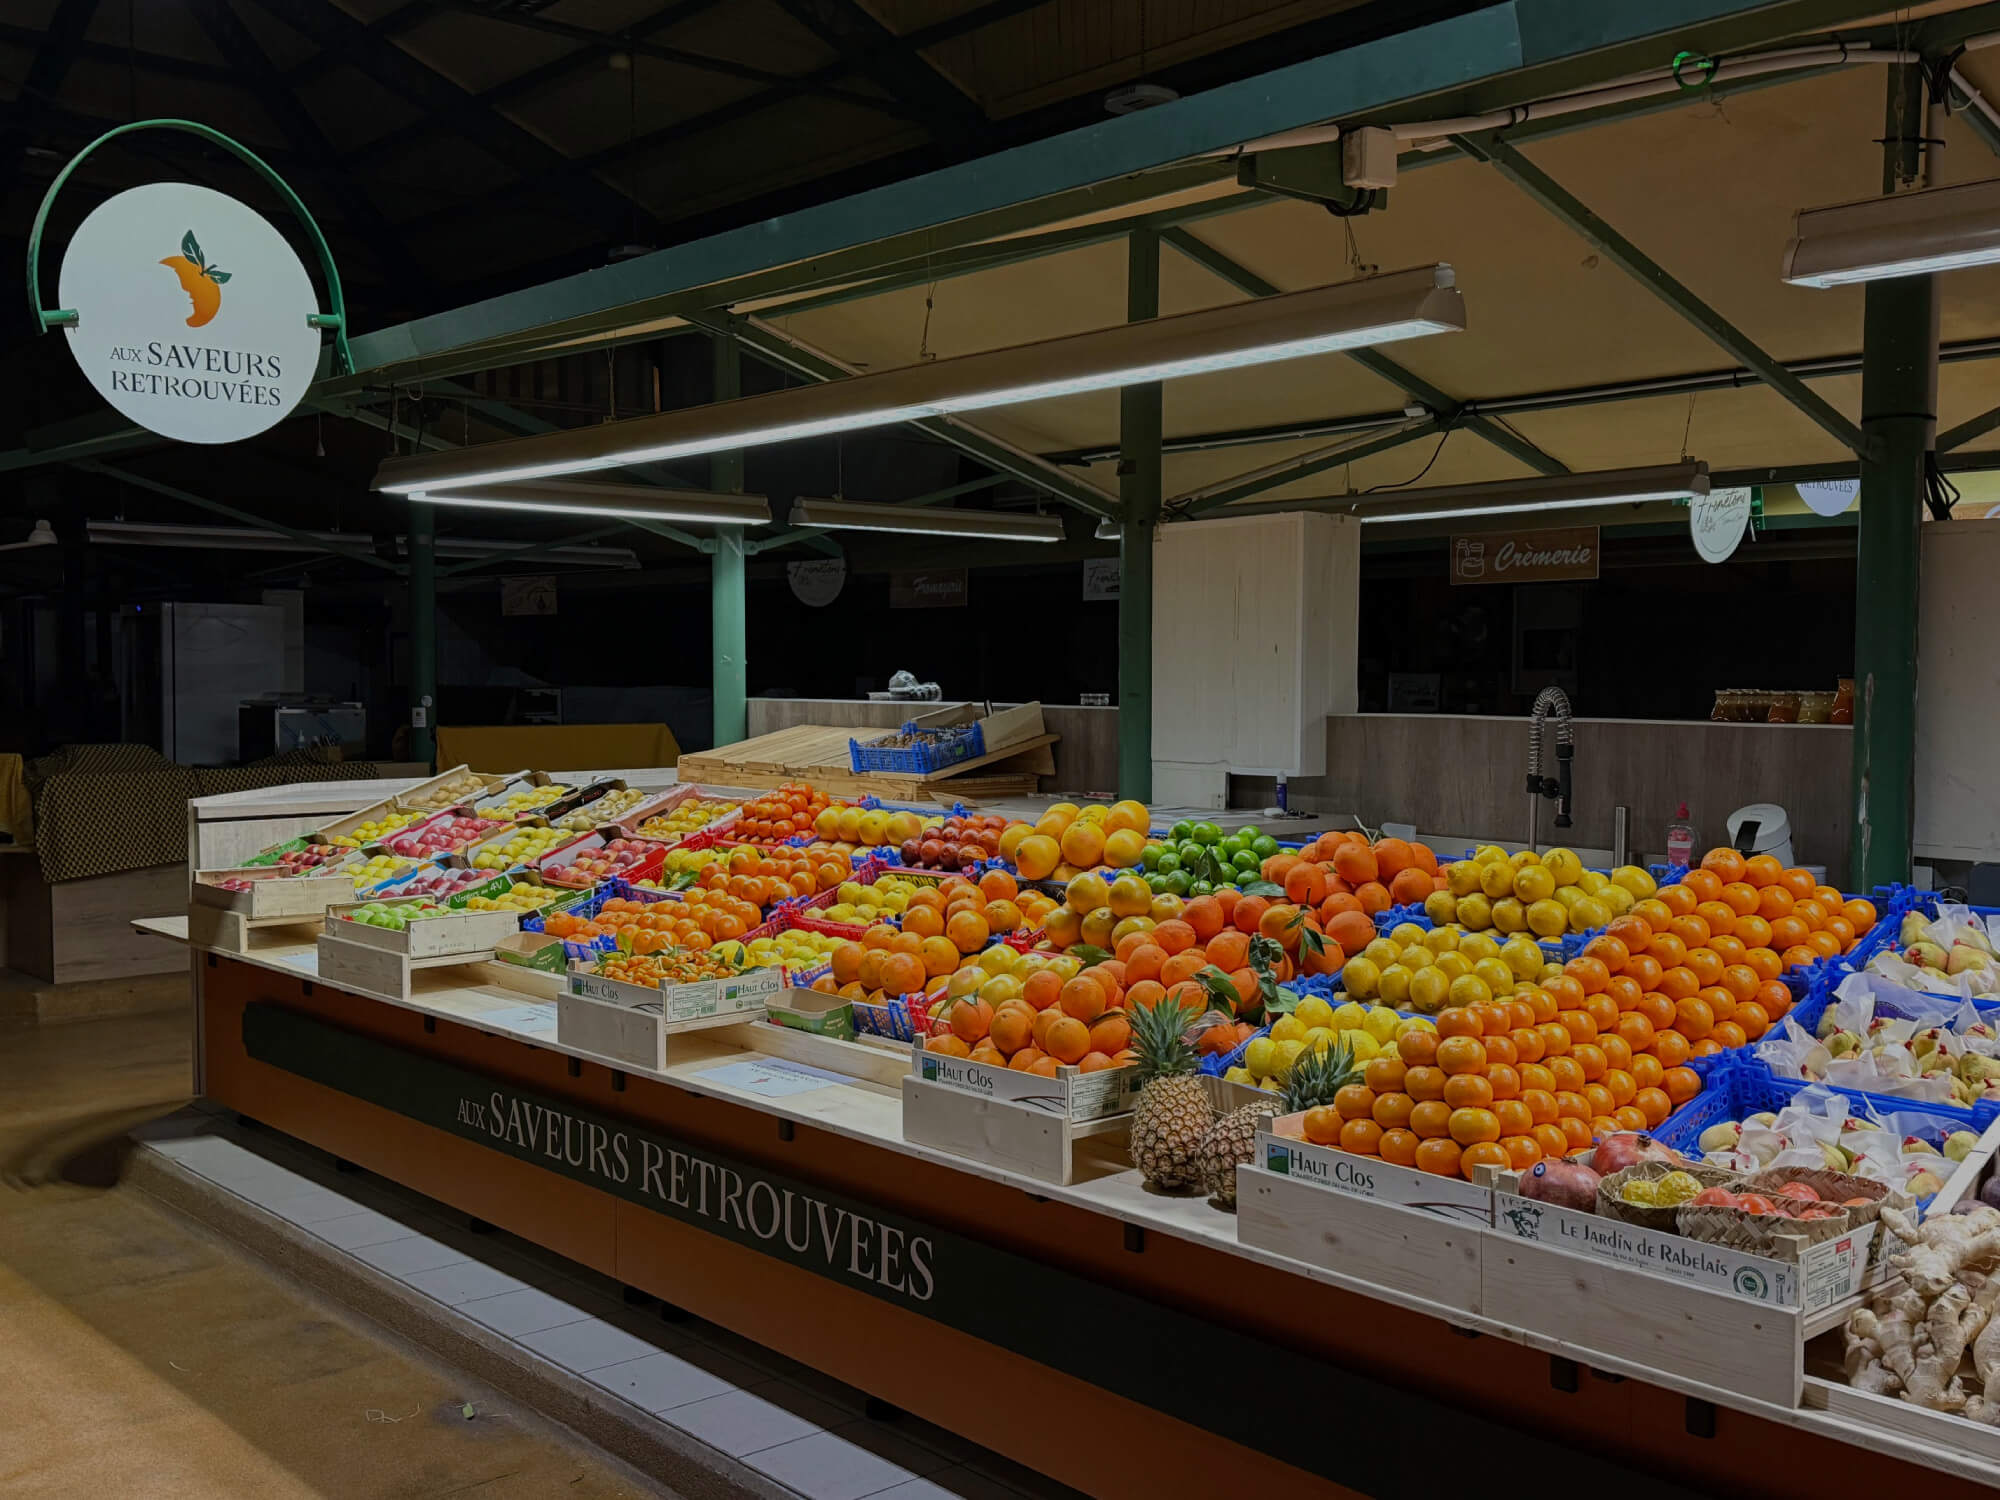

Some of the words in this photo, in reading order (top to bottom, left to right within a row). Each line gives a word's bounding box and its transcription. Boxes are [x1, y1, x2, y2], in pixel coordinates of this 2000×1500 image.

[110, 347, 142, 362] AUX
[147, 342, 281, 378] SAVEURS
[112, 370, 281, 406] RETROUVÉES
[1494, 541, 1592, 572] Crèmerie
[937, 1060, 963, 1083] Haut
[967, 1068, 993, 1089] Clos
[1290, 1149, 1328, 1177] Haut
[1335, 1161, 1374, 1189] Clos
[457, 1096, 488, 1131] AUX
[489, 1091, 630, 1184] SAVEURS
[639, 1139, 936, 1302] RETROUVEES
[1560, 1219, 1577, 1237] Le
[1584, 1225, 1632, 1251] Jardin
[1637, 1238, 1655, 1259] de
[1661, 1244, 1728, 1277] Rabelais
